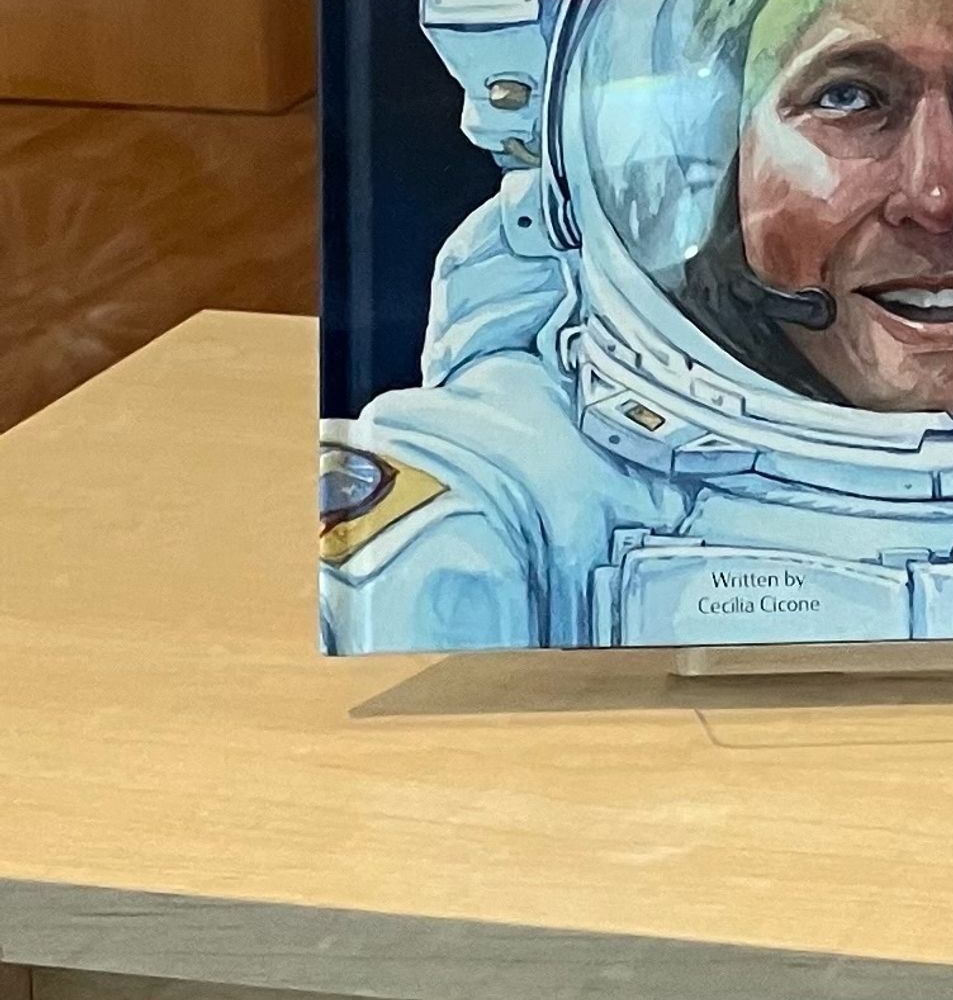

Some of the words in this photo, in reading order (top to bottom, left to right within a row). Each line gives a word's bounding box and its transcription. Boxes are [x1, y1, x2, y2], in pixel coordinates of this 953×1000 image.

[711, 570, 779, 588] Written
[784, 569, 806, 591] by
[698, 595, 755, 615] Cecilia
[760, 594, 820, 613] Cicone
